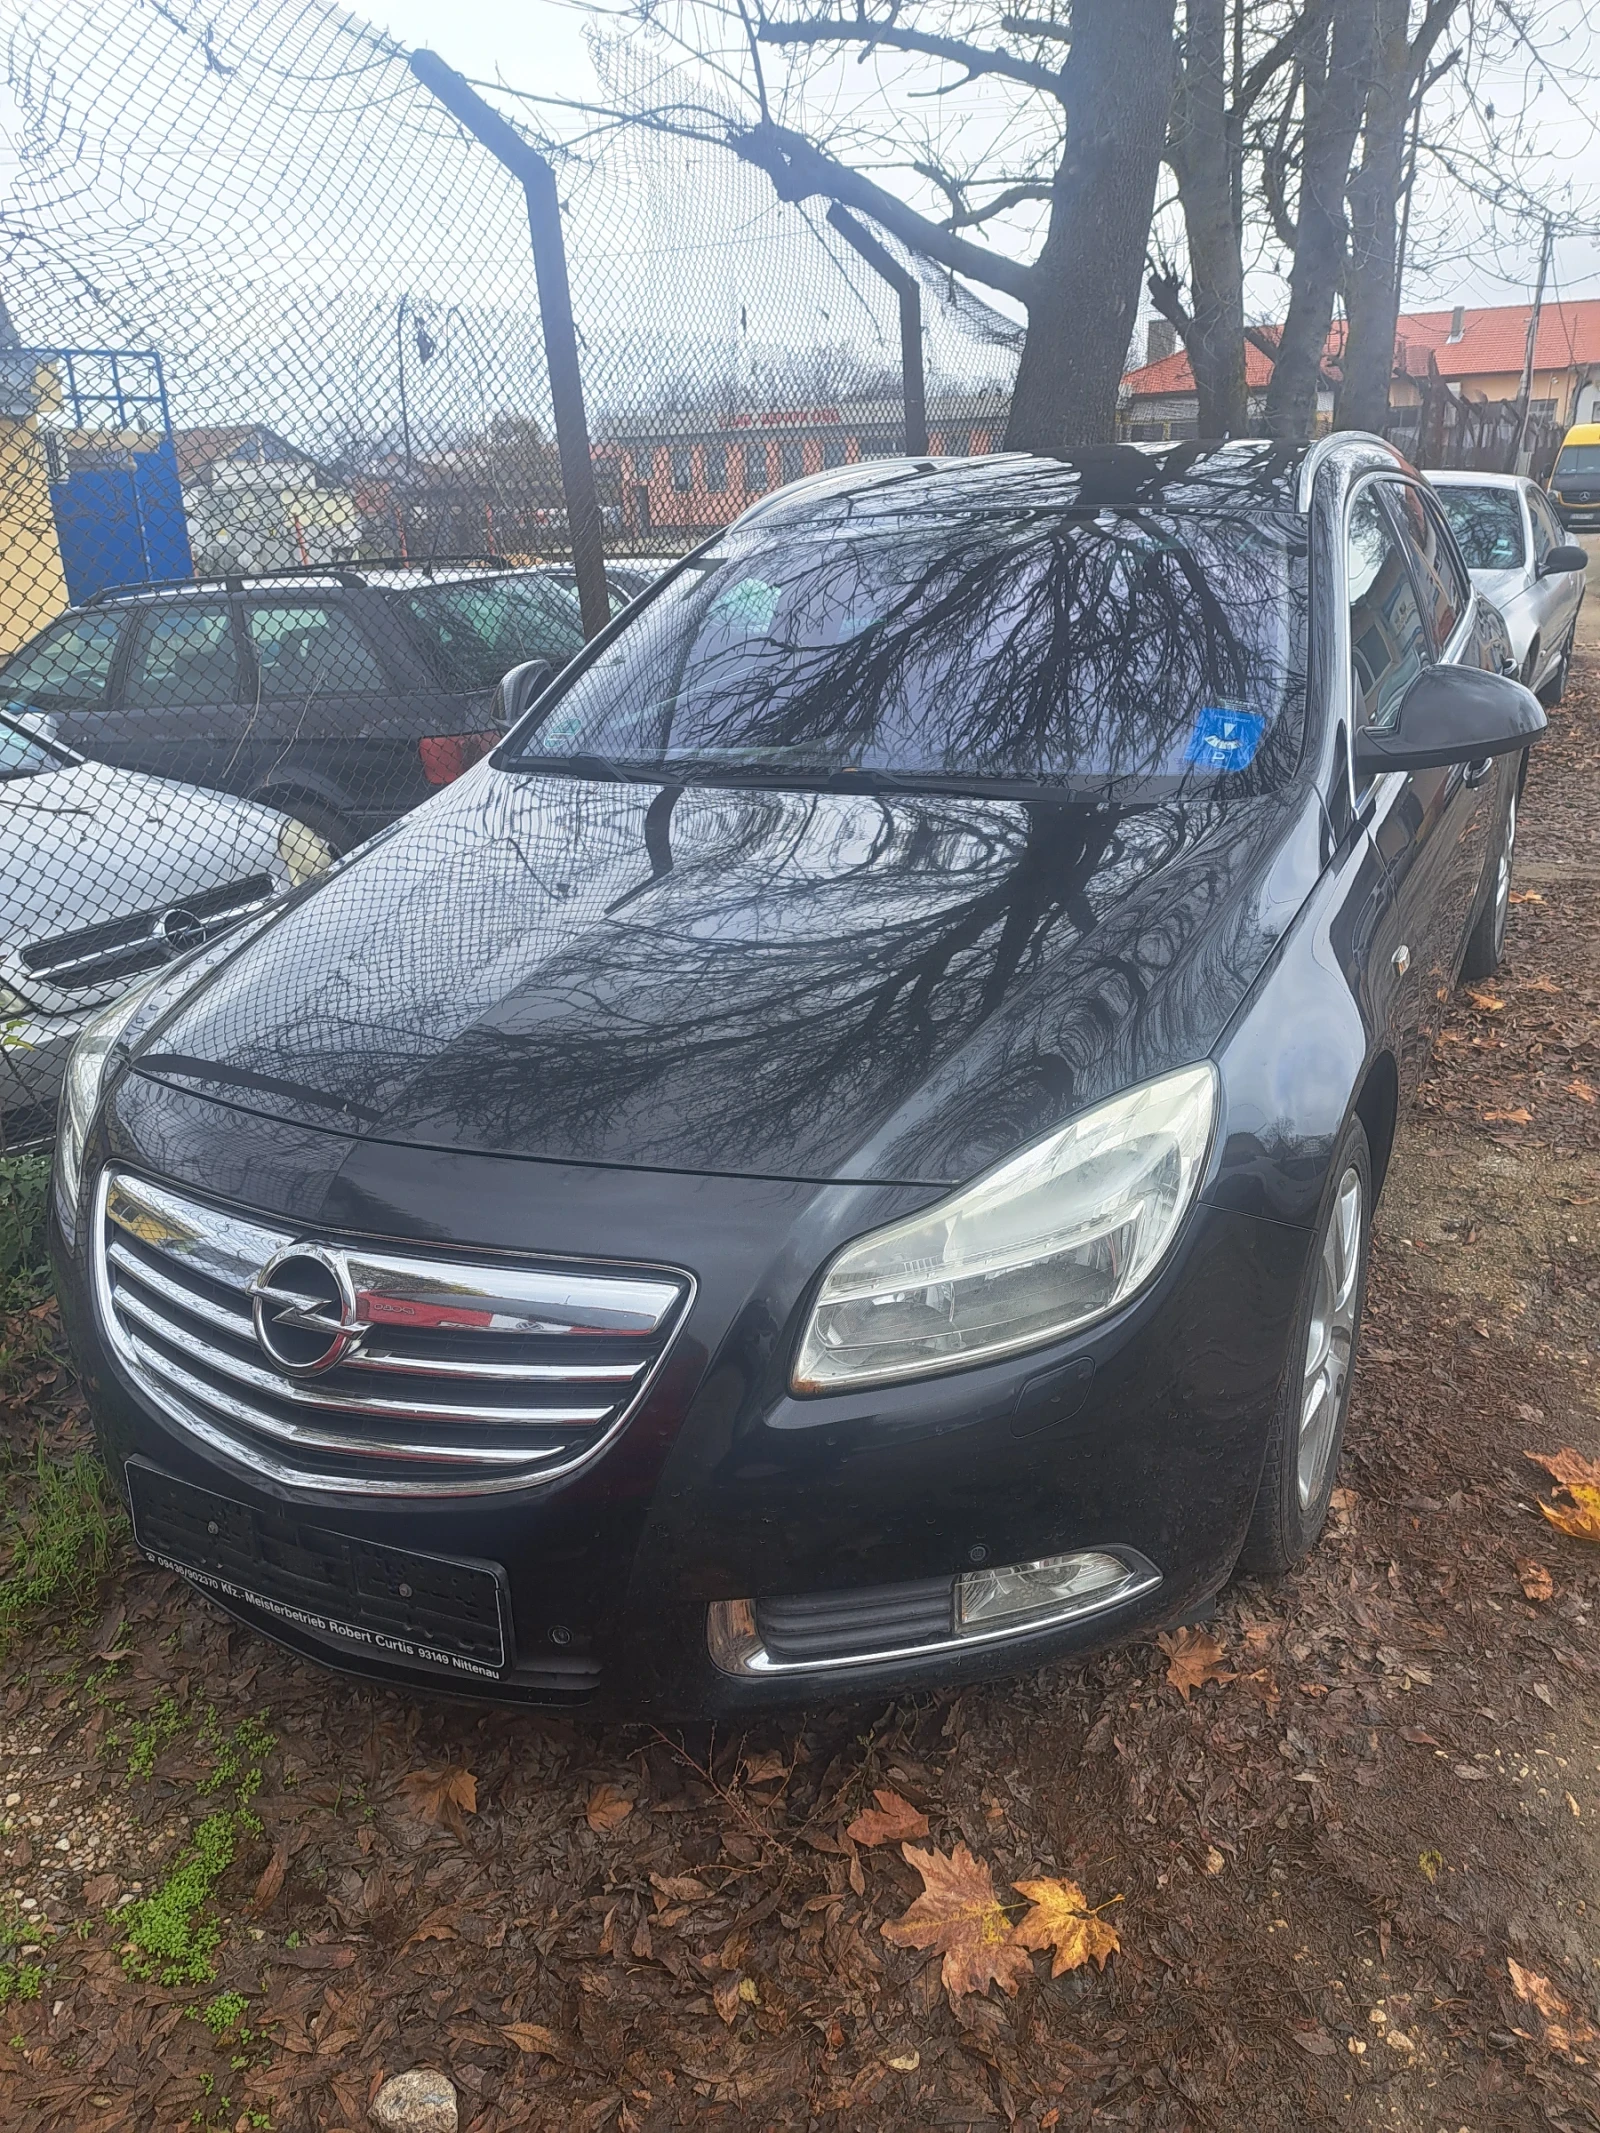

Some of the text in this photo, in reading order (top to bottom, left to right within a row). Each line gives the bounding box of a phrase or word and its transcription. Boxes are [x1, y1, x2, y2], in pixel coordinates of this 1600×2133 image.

[221, 1581, 326, 1630] Kfz.-Meisterbetrieb
[329, 1621, 373, 1644] Robert
[375, 1634, 414, 1655] Curtis
[418, 1648, 450, 1665] 93149
[452, 1656, 500, 1680] Nittenau
